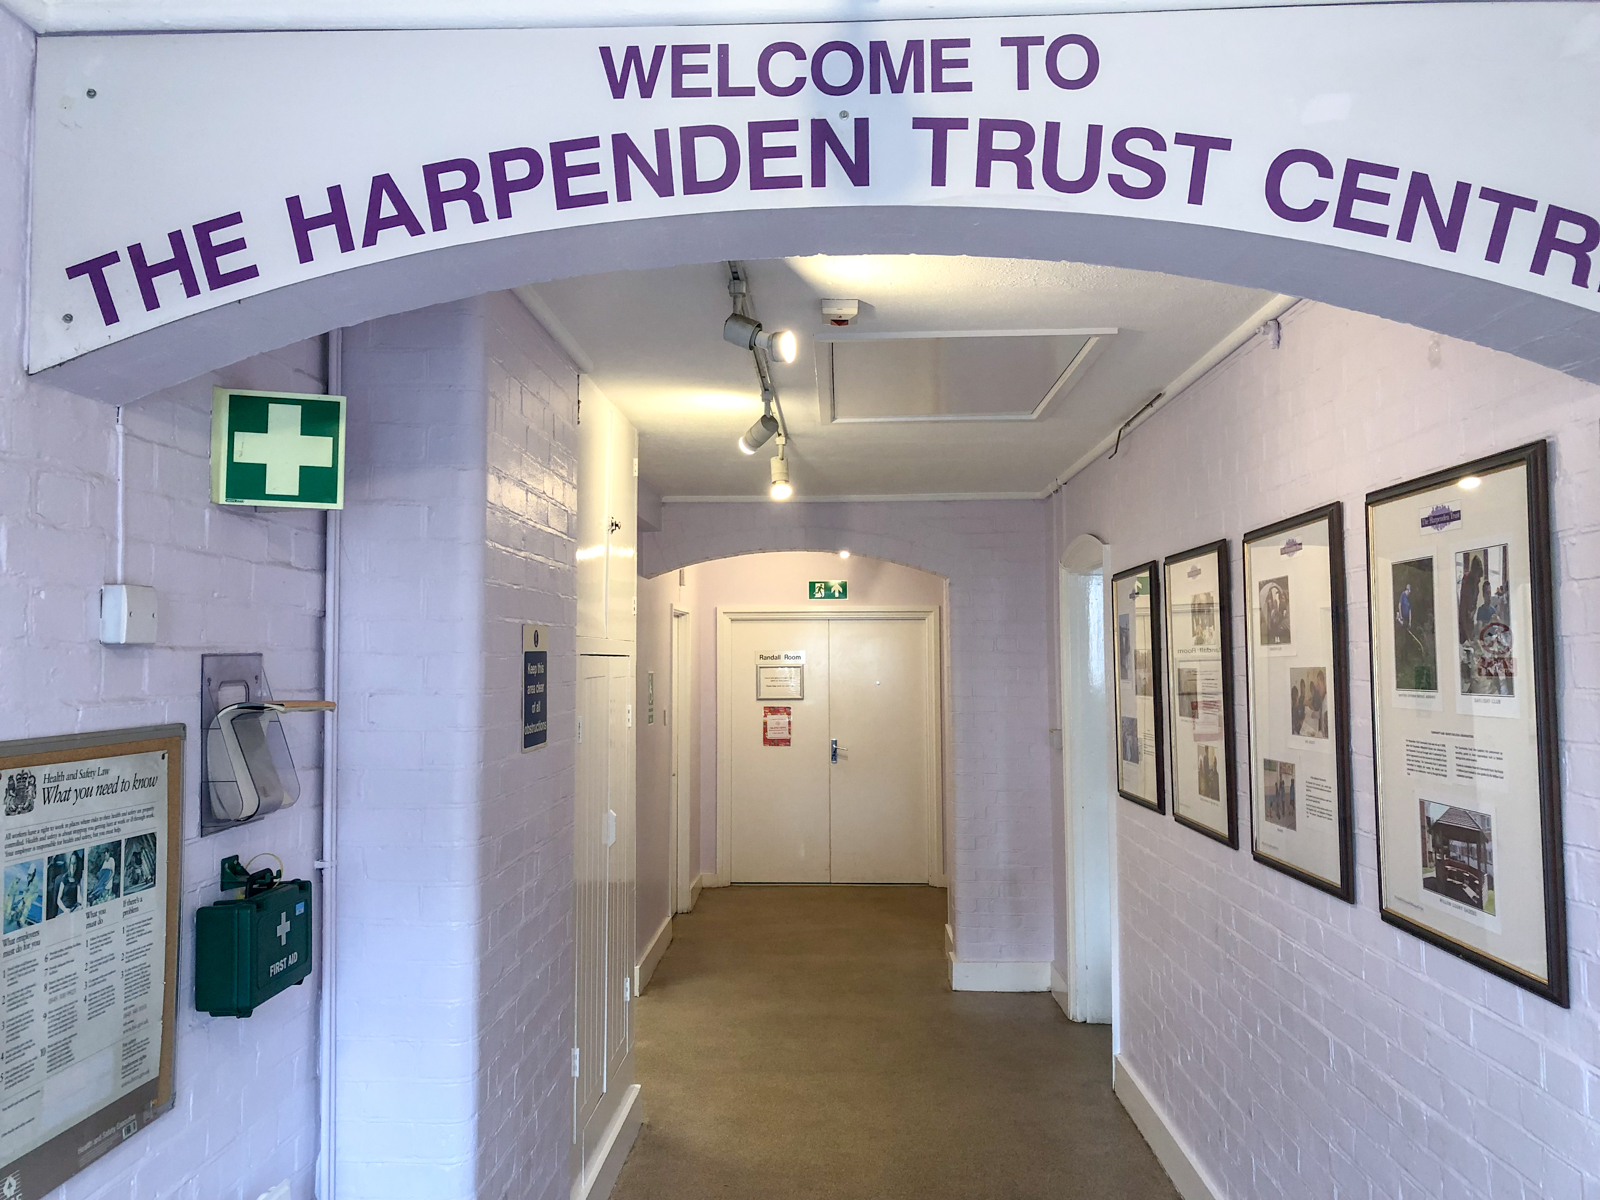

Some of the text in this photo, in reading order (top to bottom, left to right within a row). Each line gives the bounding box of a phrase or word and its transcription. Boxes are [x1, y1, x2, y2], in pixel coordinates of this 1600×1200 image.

[600, 33, 1100, 100] WELCOME TO
[66, 117, 1600, 326] THE HARPENDEN TRUST CENTR
[527, 662, 545, 677] Keep this
[526, 681, 545, 695] area clear
[524, 720, 547, 735] obstructions
[43, 766, 110, 784] Health and Safety Law
[42, 772, 158, 806] What you need to know
[85, 909, 107, 920] What you
[86, 916, 104, 929] must do
[2, 930, 40, 947] What employers
[3, 940, 41, 958] must do for you
[269, 951, 298, 978] FIRST AID
